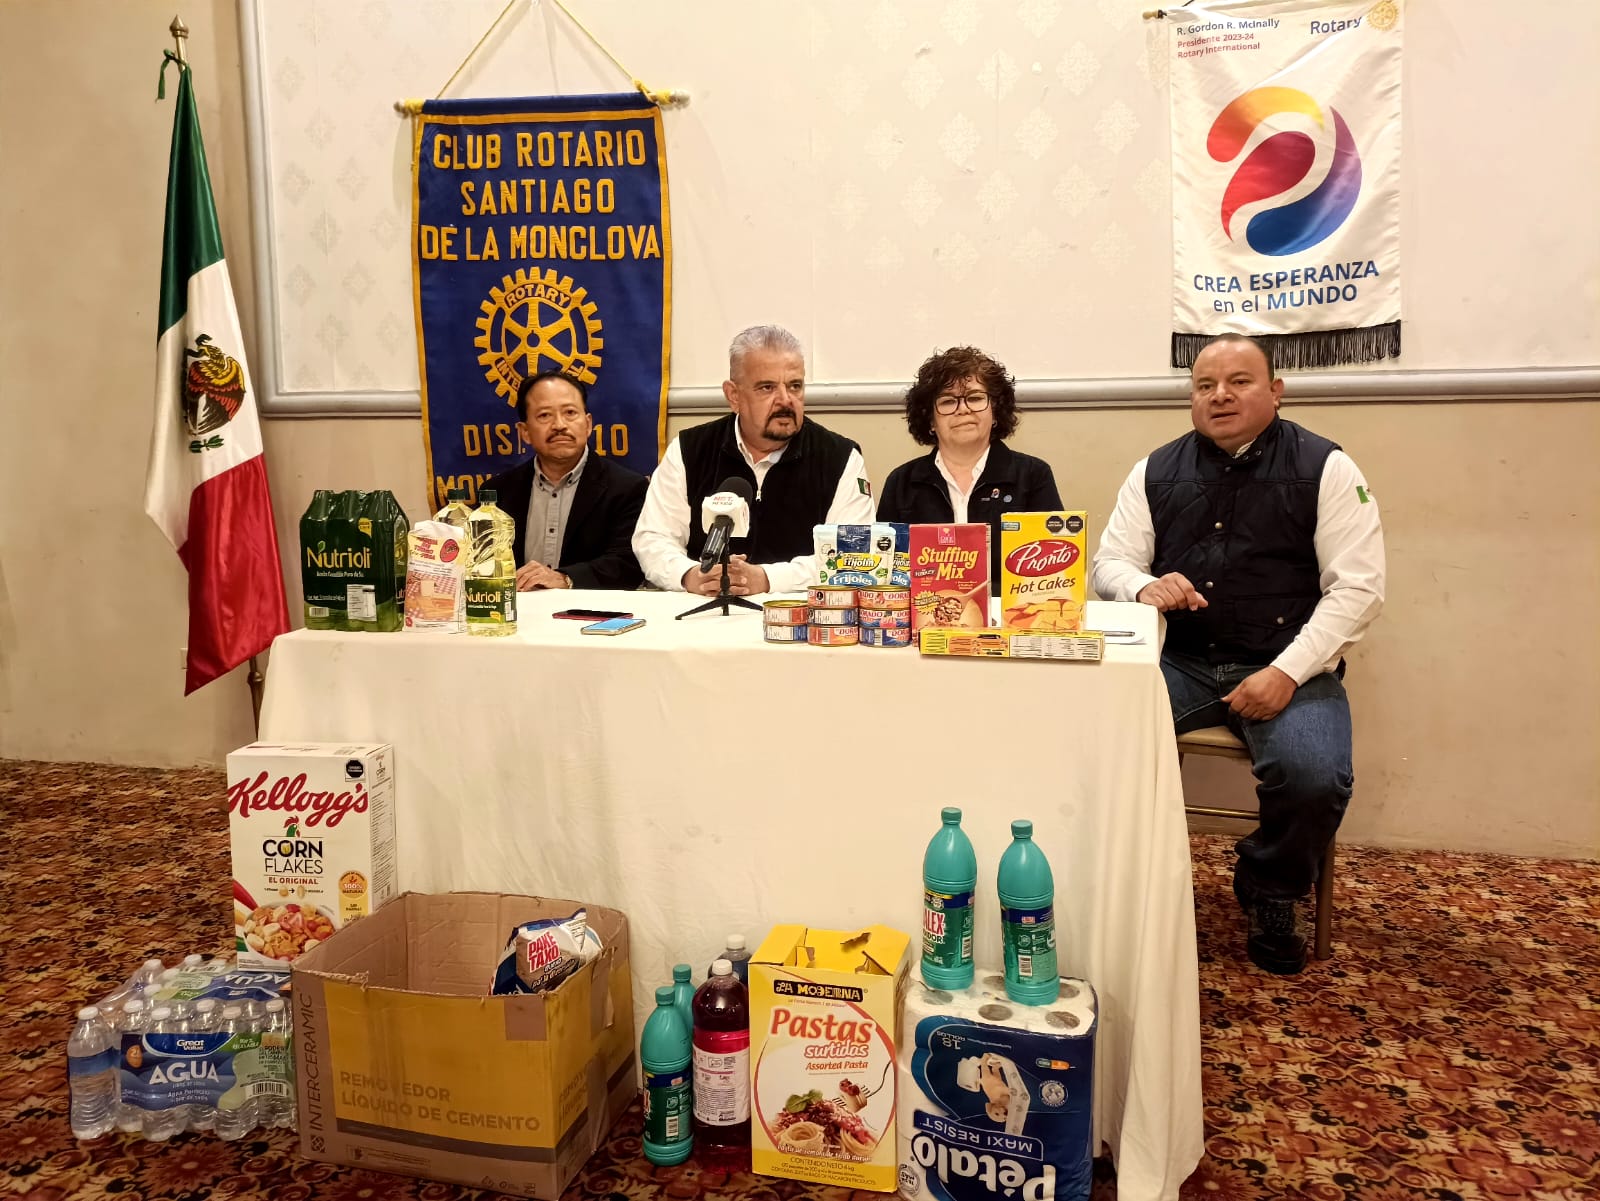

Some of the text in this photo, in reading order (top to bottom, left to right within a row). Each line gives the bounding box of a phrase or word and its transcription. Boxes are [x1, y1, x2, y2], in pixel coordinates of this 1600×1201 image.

[1187, 22, 1224, 34] Gordon
[1238, 18, 1280, 29] McInally
[1310, 16, 1362, 35] Rotary
[1177, 33, 1254, 48] Presidente 2023-24
[1177, 41, 1260, 58] Rotary International
[433, 129, 646, 170] CLUB ROTARIO
[460, 178, 615, 216] SANTIAGO
[420, 225, 661, 261] DE LA MONCLOVA
[1193, 260, 1379, 293] CREA ESPERANZA
[505, 283, 572, 307] ROTARY
[1213, 284, 1358, 313] en el MUNDO
[592, 424, 629, 456] 10
[306, 546, 371, 569] Nutrioli
[916, 546, 979, 570] Stuffing
[1009, 541, 1072, 574] Pronto
[832, 574, 873, 586] Frijoles
[935, 562, 966, 580] Mix
[1009, 580, 1035, 595] Hot
[1037, 577, 1076, 591] Cakes
[227, 771, 368, 828] Kellogg's
[262, 839, 323, 858] CORN
[264, 858, 323, 875] FLAKES
[279, 877, 319, 885] ORIGINAL
[528, 931, 557, 957] PAKE
[529, 944, 561, 973] TAXO
[775, 982, 861, 1000] LA MODERNA
[770, 1008, 873, 1044] Pastas
[176, 1039, 205, 1047] Great
[804, 1039, 870, 1059] surtidas
[942, 1037, 961, 1050] 18
[148, 1060, 220, 1086] AGUA
[301, 994, 324, 1131] INTERCERAMIC
[805, 1060, 869, 1070] Assorted Pasta
[341, 1089, 540, 1131] LÍQUIDO DE CEMENTO
[922, 1117, 1033, 1153] MAXI RESIST
[790, 1157, 827, 1168] CONTENIDO
[826, 1161, 844, 1170] NETO
[913, 1135, 1056, 1201] Pétalo
